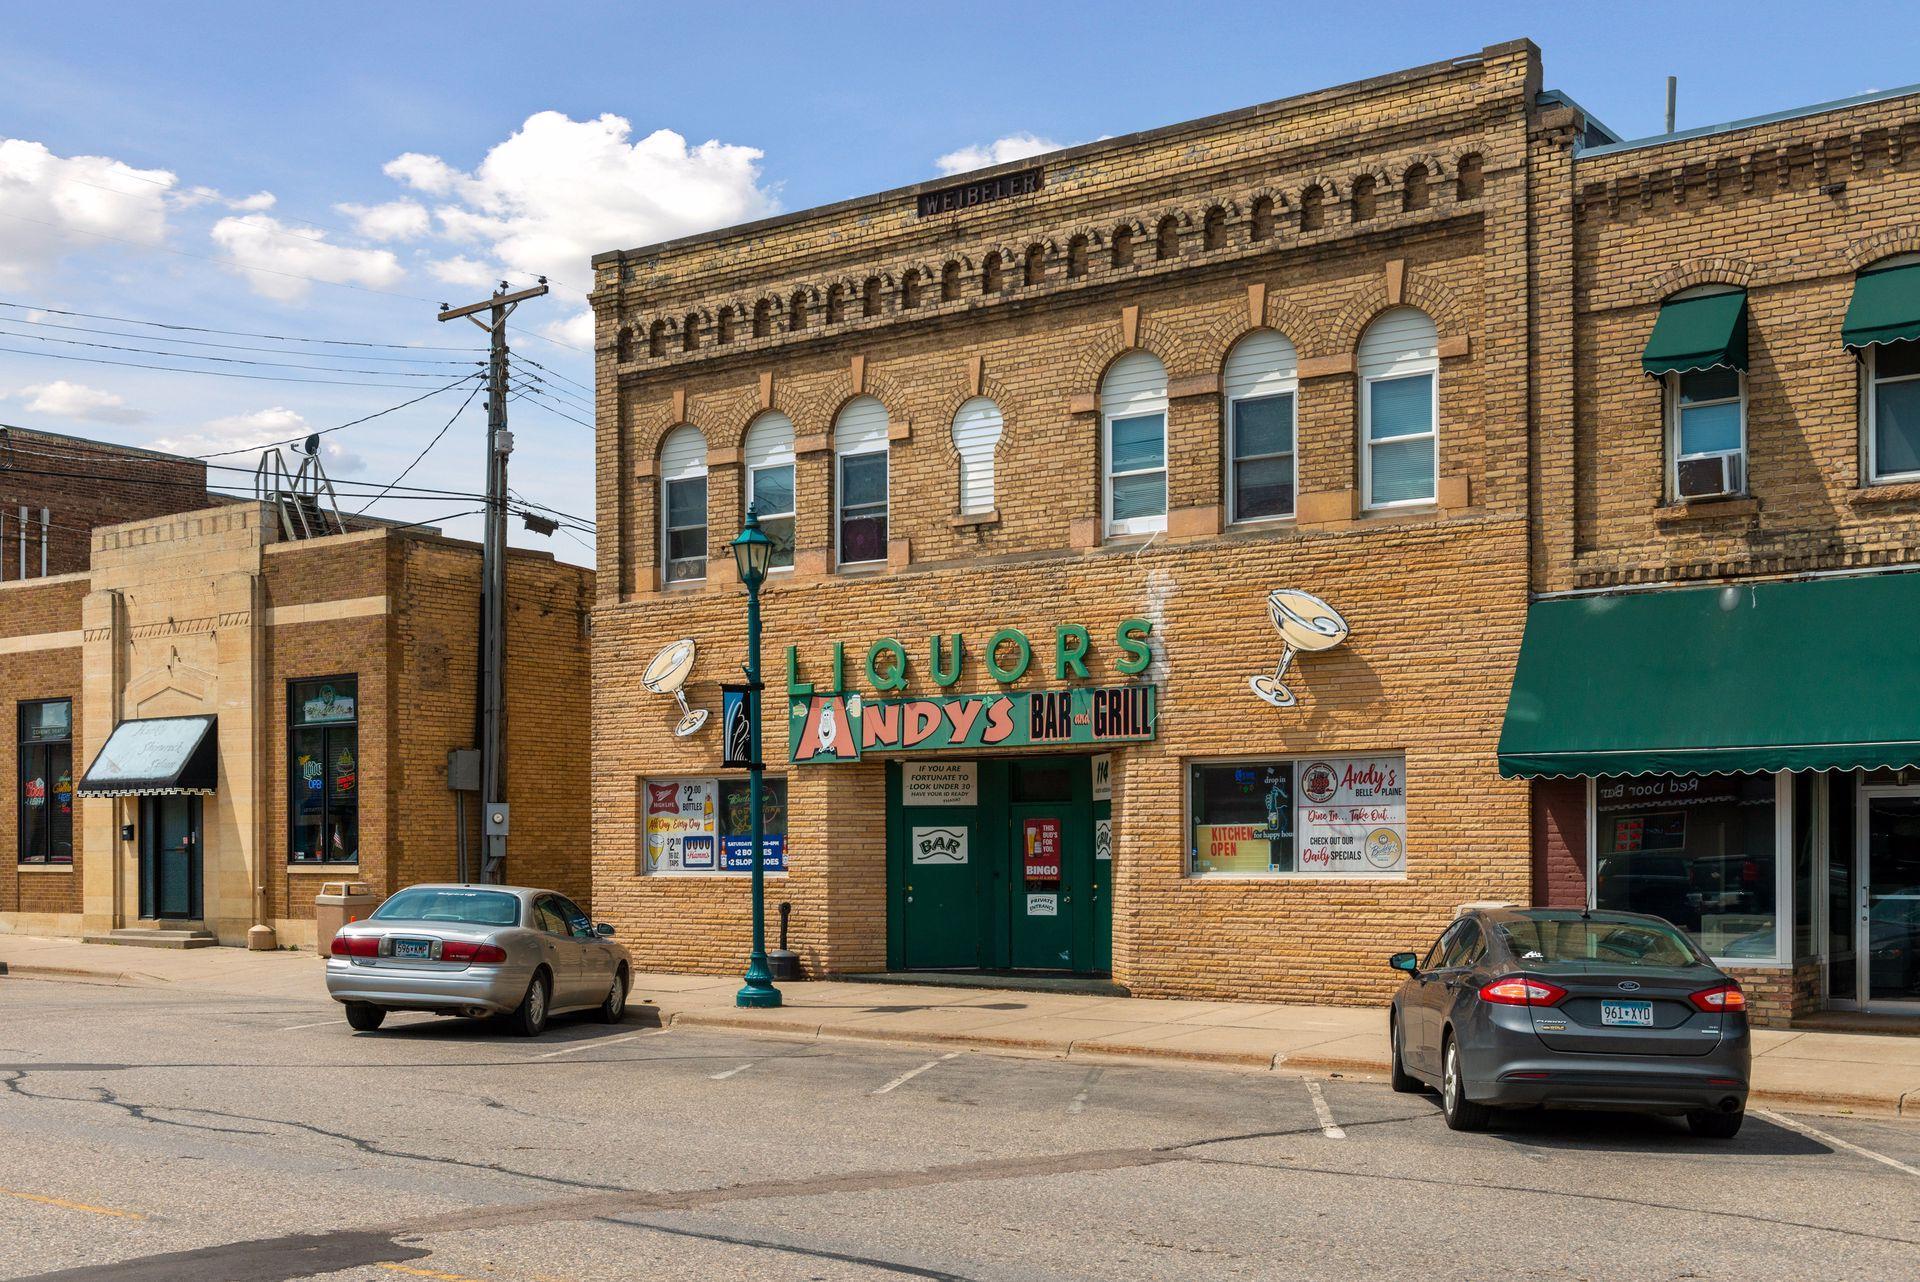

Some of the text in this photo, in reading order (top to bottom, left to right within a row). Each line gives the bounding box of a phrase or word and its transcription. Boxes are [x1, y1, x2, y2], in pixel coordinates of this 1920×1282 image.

[926, 173, 1036, 214] WEIBELER
[786, 618, 1152, 695] LIQUORS
[1030, 691, 1071, 741] BAR
[1073, 711, 1090, 726] and
[1093, 687, 1151, 737] GRILL
[1264, 775, 1279, 785] drop
[1280, 775, 1287, 783] in
[1340, 763, 1397, 793] Andy's
[1356, 787, 1402, 797] BELLE PLAINE
[682, 803, 702, 811] BOTTLES
[1308, 809, 1327, 822] Dine
[1349, 808, 1369, 822] Take
[1211, 827, 1253, 841] KITCHEN
[1263, 831, 1280, 840] happy
[1281, 830, 1294, 838] hou
[1310, 836, 1353, 845] CHECK OUT OUR
[919, 836, 961, 855] BAR
[1211, 842, 1237, 856] OPEN
[1303, 847, 1361, 866] Daily SPECIALS
[1026, 866, 1058, 875] BINGO
[1029, 903, 1055, 911] ENTRANCE
[1604, 1006, 1623, 1019] 961
